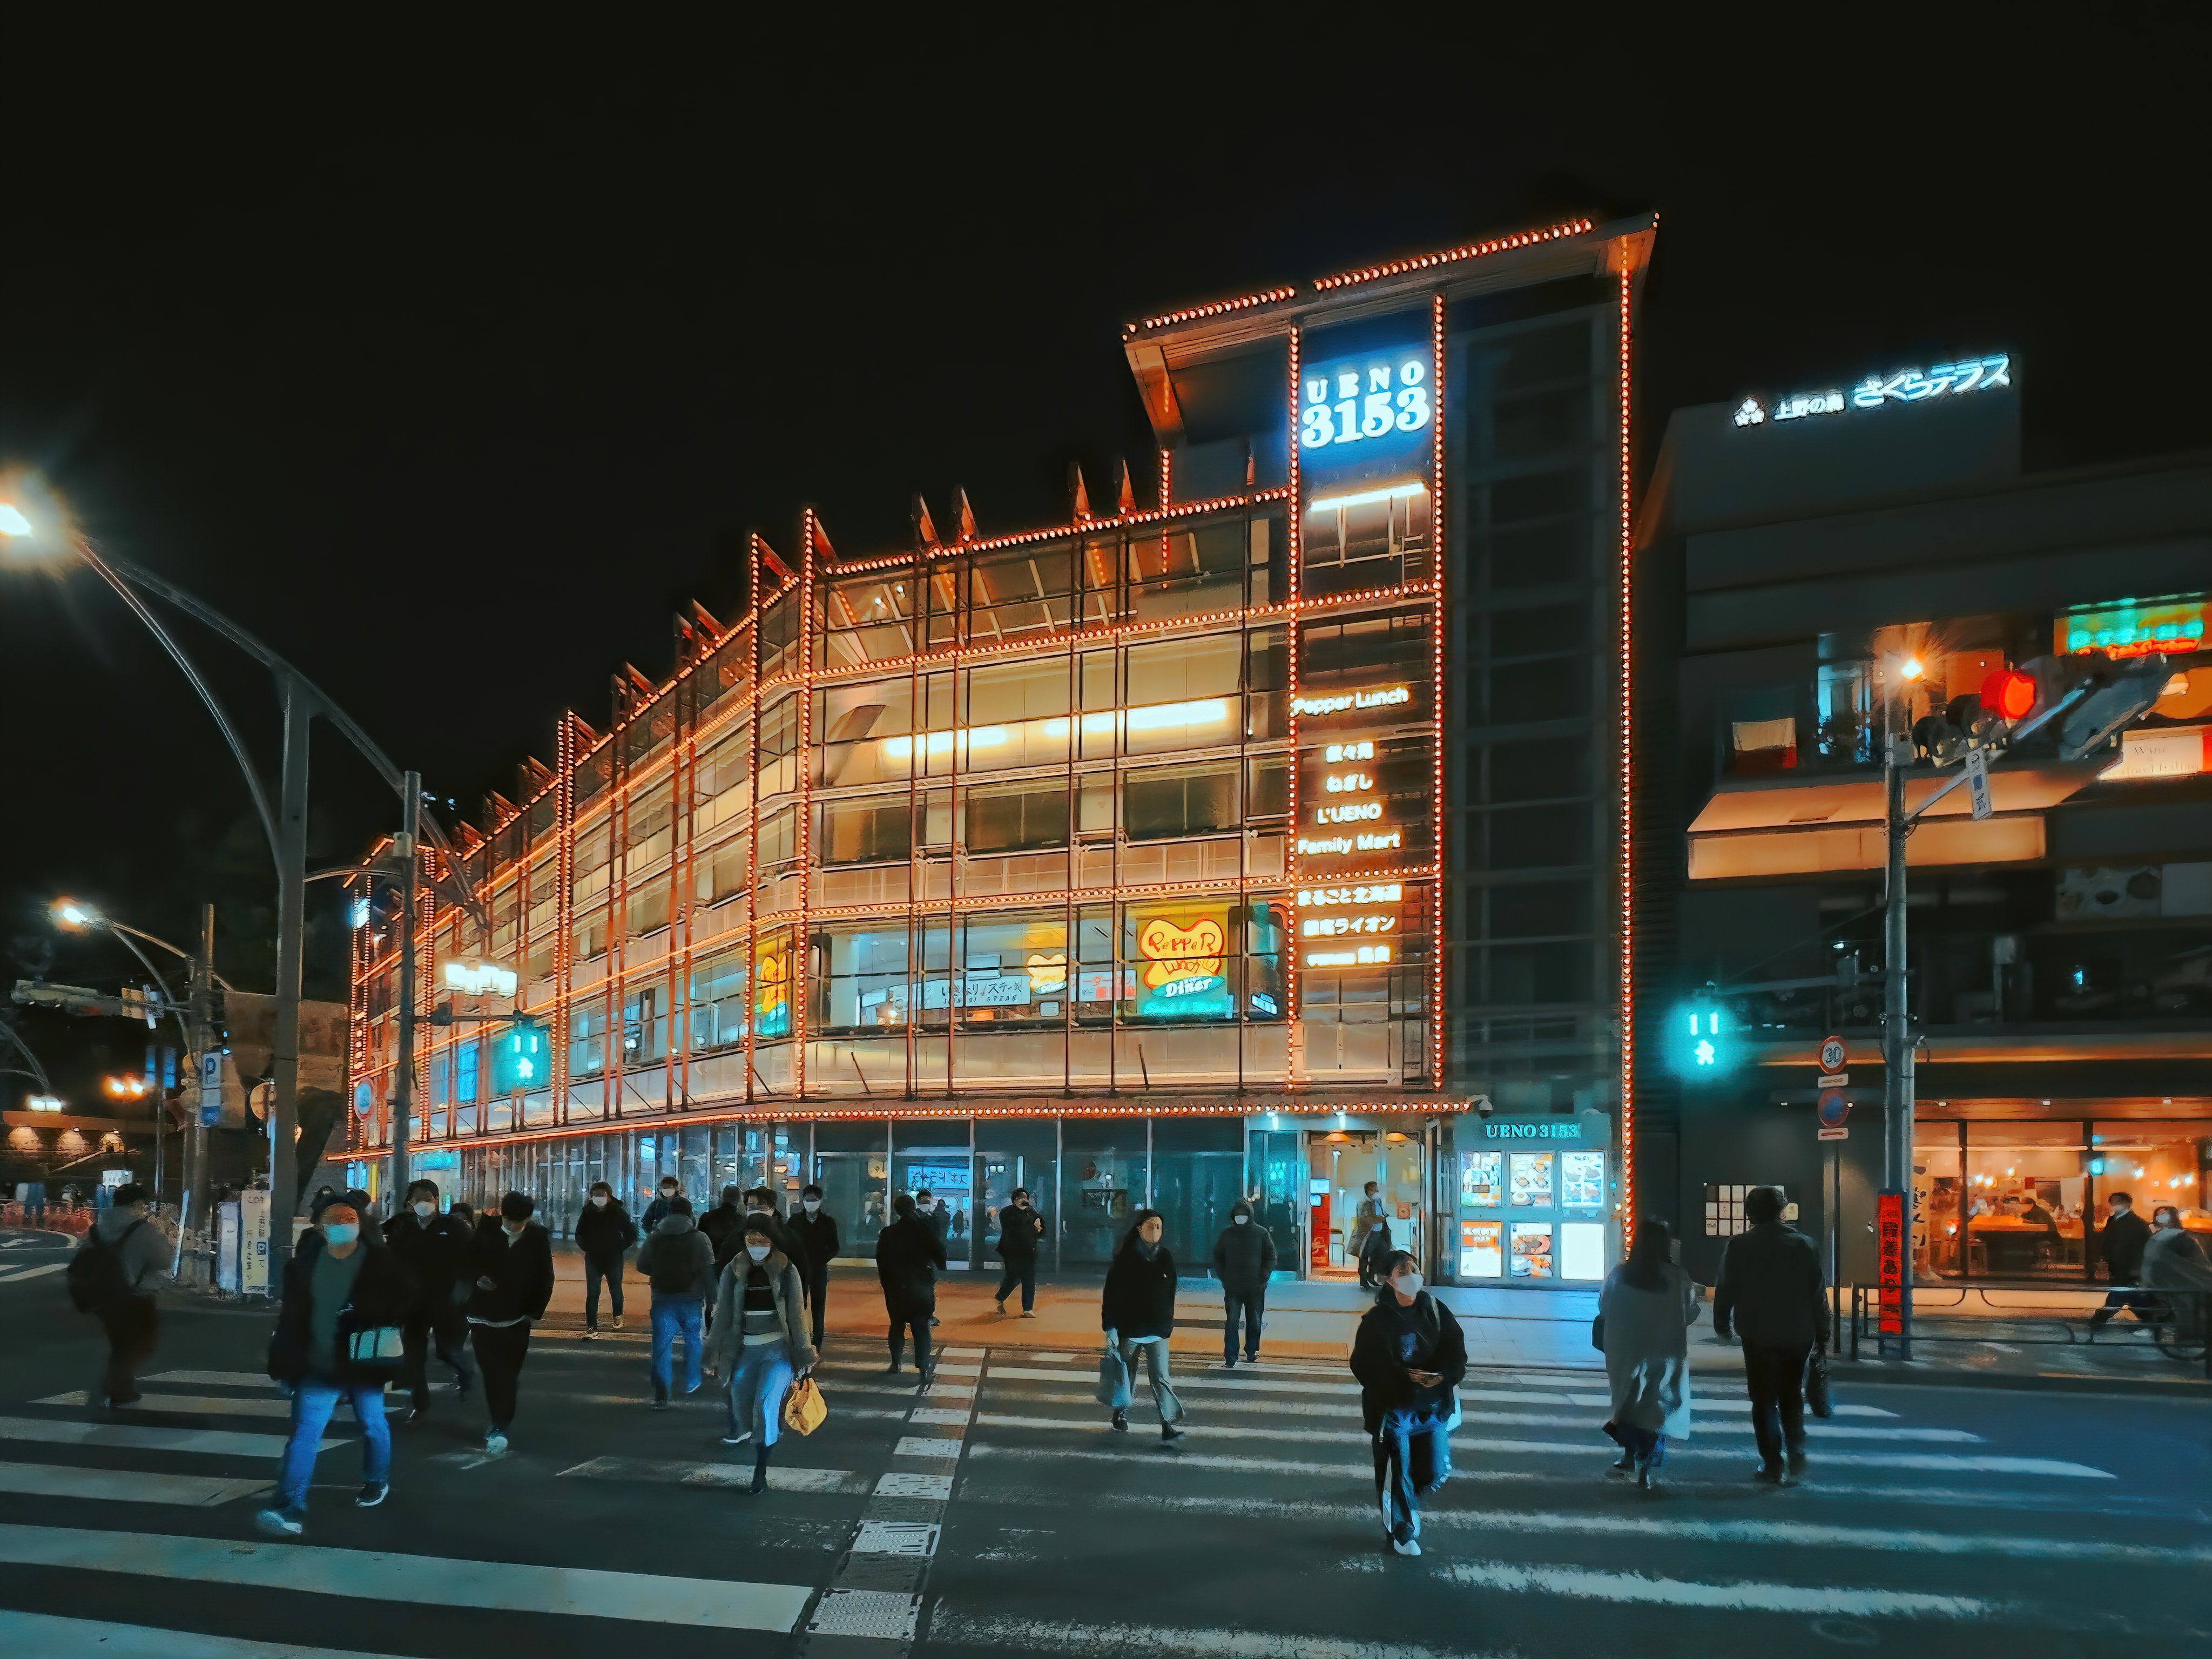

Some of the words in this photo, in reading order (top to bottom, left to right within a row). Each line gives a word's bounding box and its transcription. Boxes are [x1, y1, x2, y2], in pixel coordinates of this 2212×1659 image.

[1306, 360, 1425, 404] UENO
[1774, 394, 1845, 420] 上の
[1853, 353, 2011, 408] さくらテラス
[1301, 387, 1431, 449] 3153
[1291, 695, 1354, 717] Pepper
[1355, 686, 1409, 709] Lunch
[1317, 802, 1383, 825] L'UENO
[1297, 836, 1353, 855] Family
[1356, 832, 1401, 851] Mart
[1303, 915, 1396, 937] ライオン
[1825, 1046, 1842, 1064] 30
[1485, 1123, 1536, 1138] UENO
[1539, 1123, 1579, 1138] 3153
